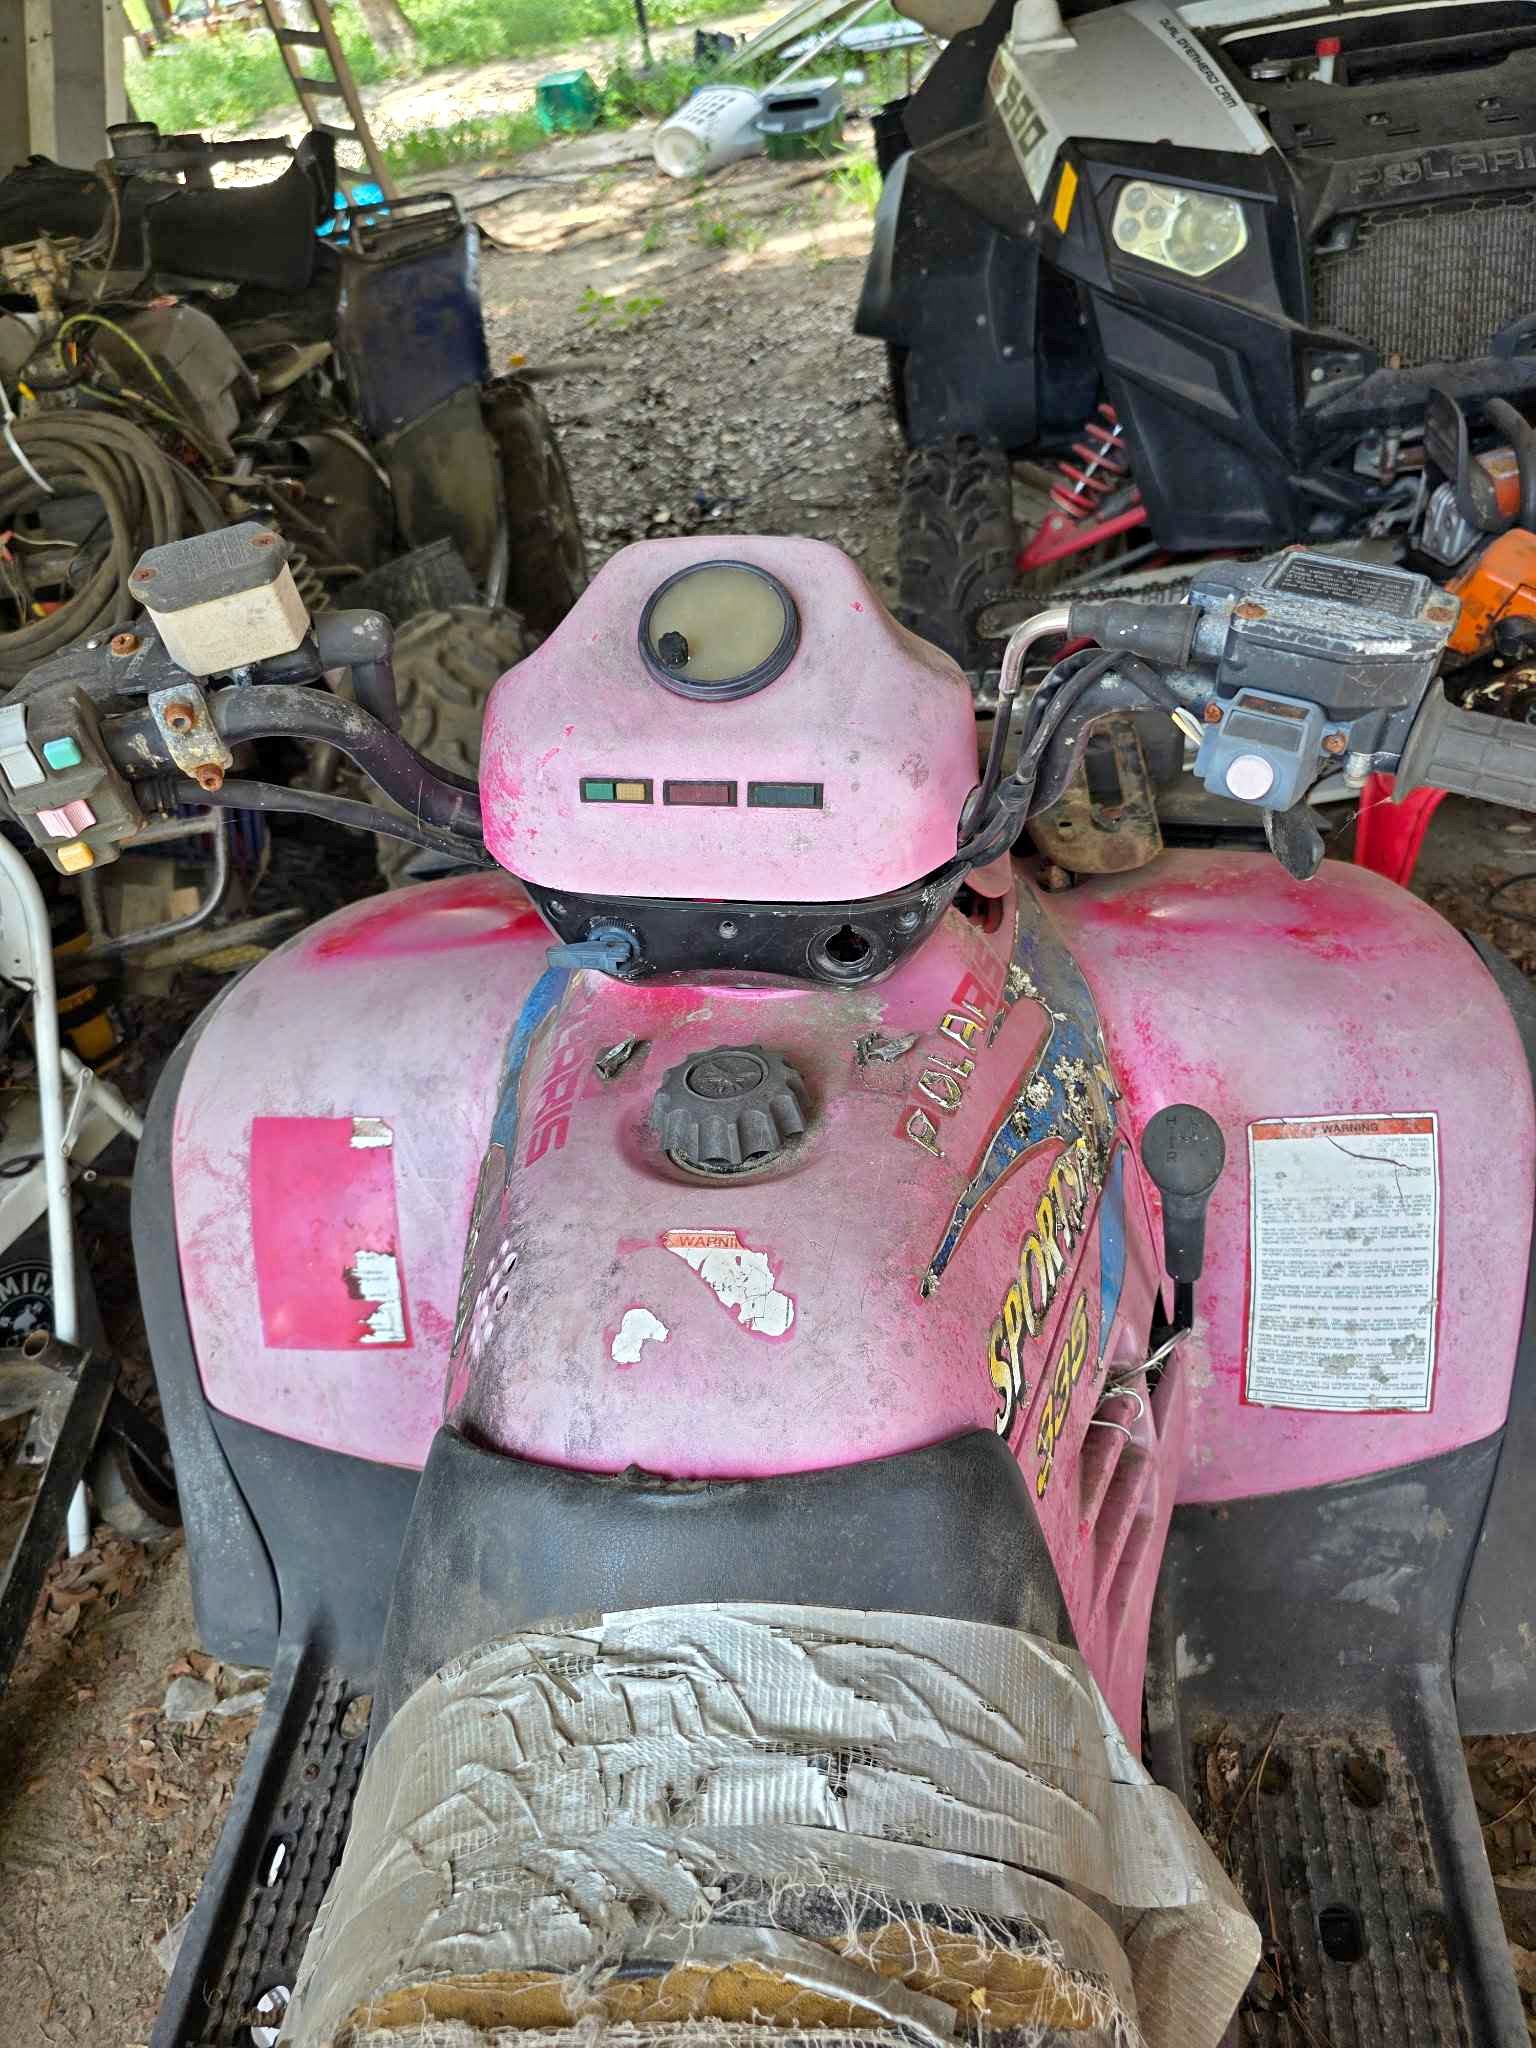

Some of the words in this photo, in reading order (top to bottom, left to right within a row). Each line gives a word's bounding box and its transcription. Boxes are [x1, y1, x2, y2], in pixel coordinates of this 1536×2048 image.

[1177, 38, 1220, 84] OVERHEAD
[1214, 84, 1239, 109] CAM
[1000, 74, 1049, 159] 900
[1351, 147, 1536, 194] POLARI
[1321, 1123, 1380, 1134] WARNING
[679, 1236, 739, 1248] WARNI
[0, 1272, 54, 1302] MIC
